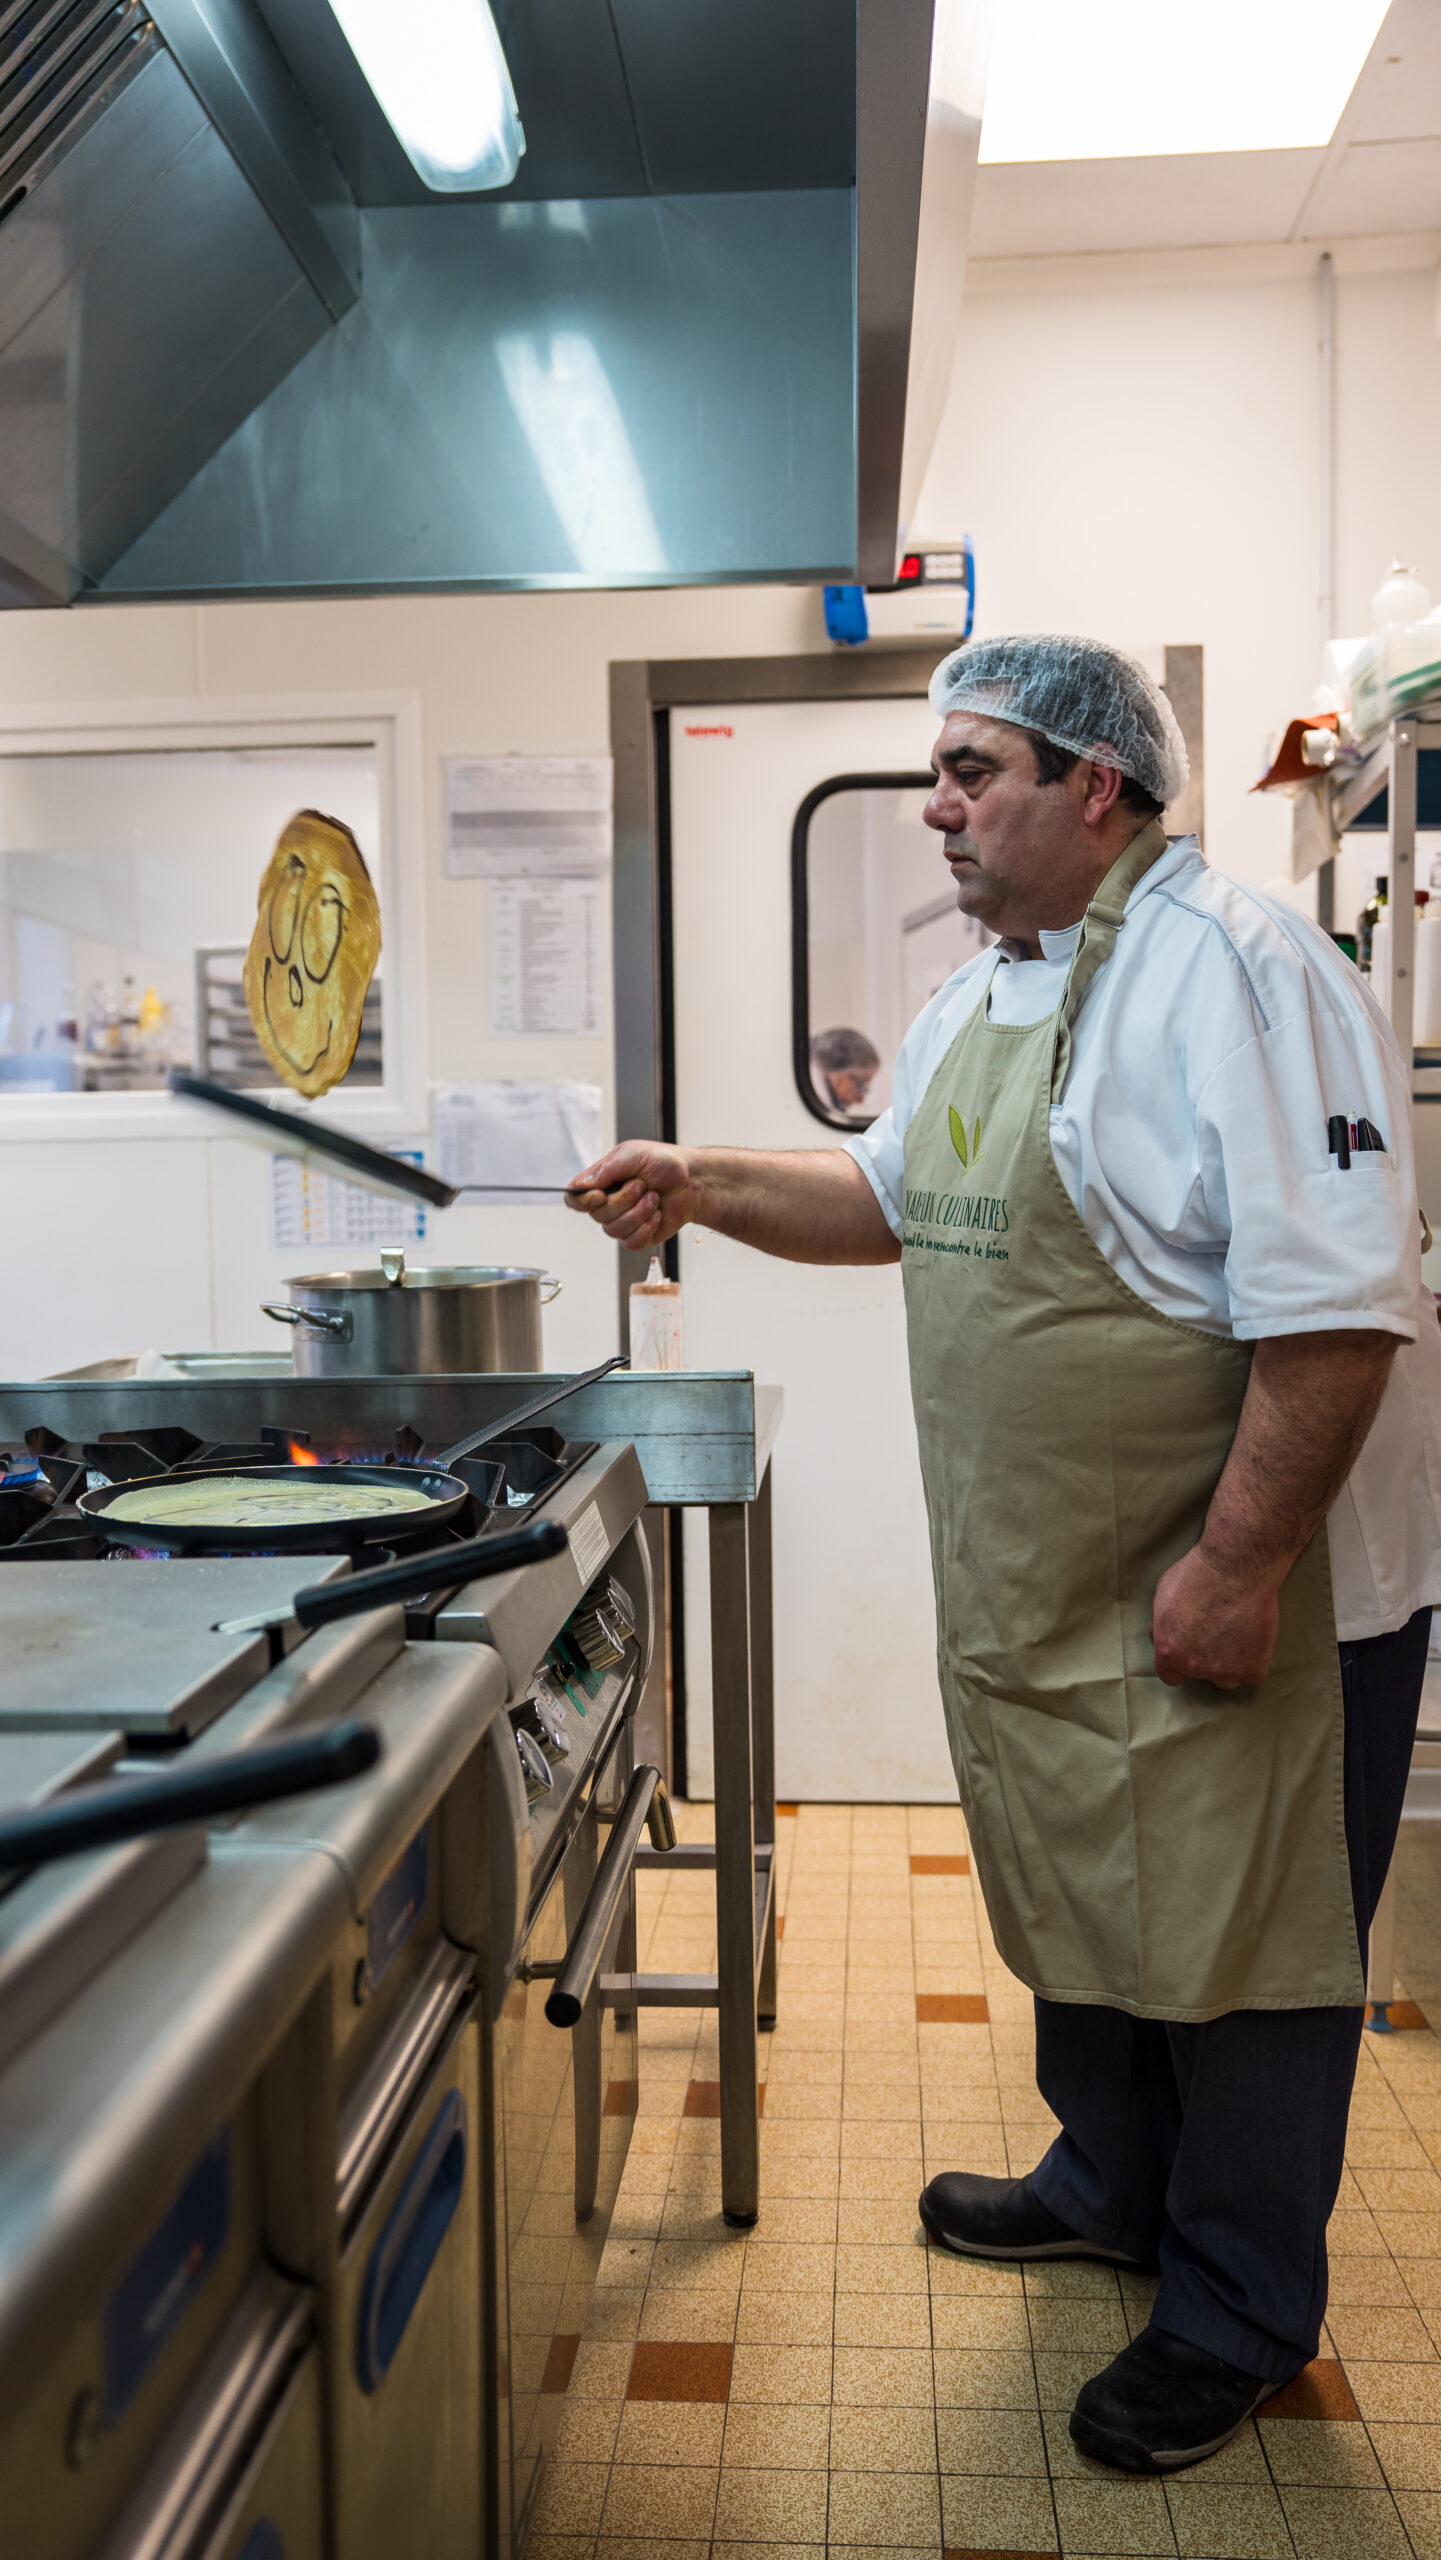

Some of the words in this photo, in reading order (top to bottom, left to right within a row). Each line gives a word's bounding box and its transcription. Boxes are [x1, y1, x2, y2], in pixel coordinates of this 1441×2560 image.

[936, 1194, 1009, 1232] CULINAIRES
[933, 1240, 971, 1256] rencontre
[974, 1241, 982, 1257] le
[985, 1241, 1009, 1260] bien
